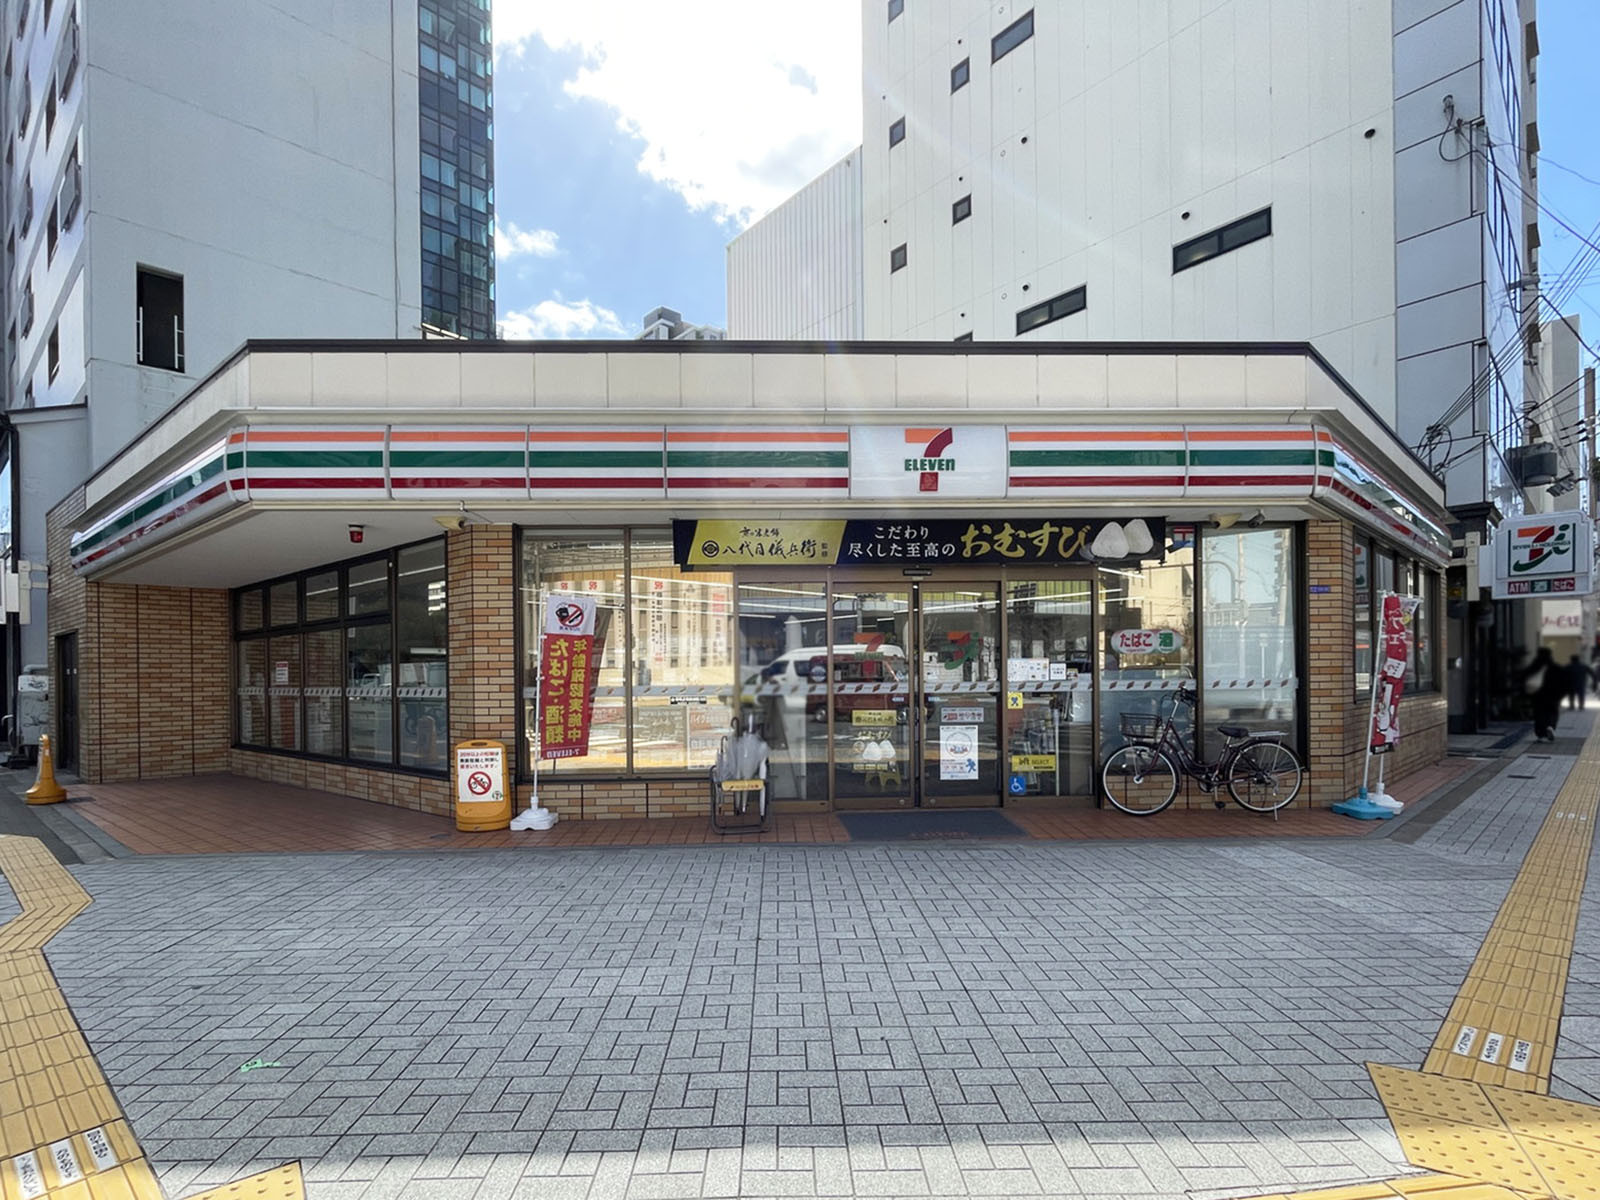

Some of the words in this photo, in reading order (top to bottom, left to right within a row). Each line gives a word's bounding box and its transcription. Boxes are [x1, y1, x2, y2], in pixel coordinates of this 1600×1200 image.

[874, 525, 929, 540] こだわり
[960, 521, 1092, 558] おむすび
[722, 538, 818, 560] 八代目儀兵衛
[847, 542, 956, 558] 尽くした至高の
[1509, 582, 1529, 594] ATM
[1120, 632, 1153, 648] たばこ
